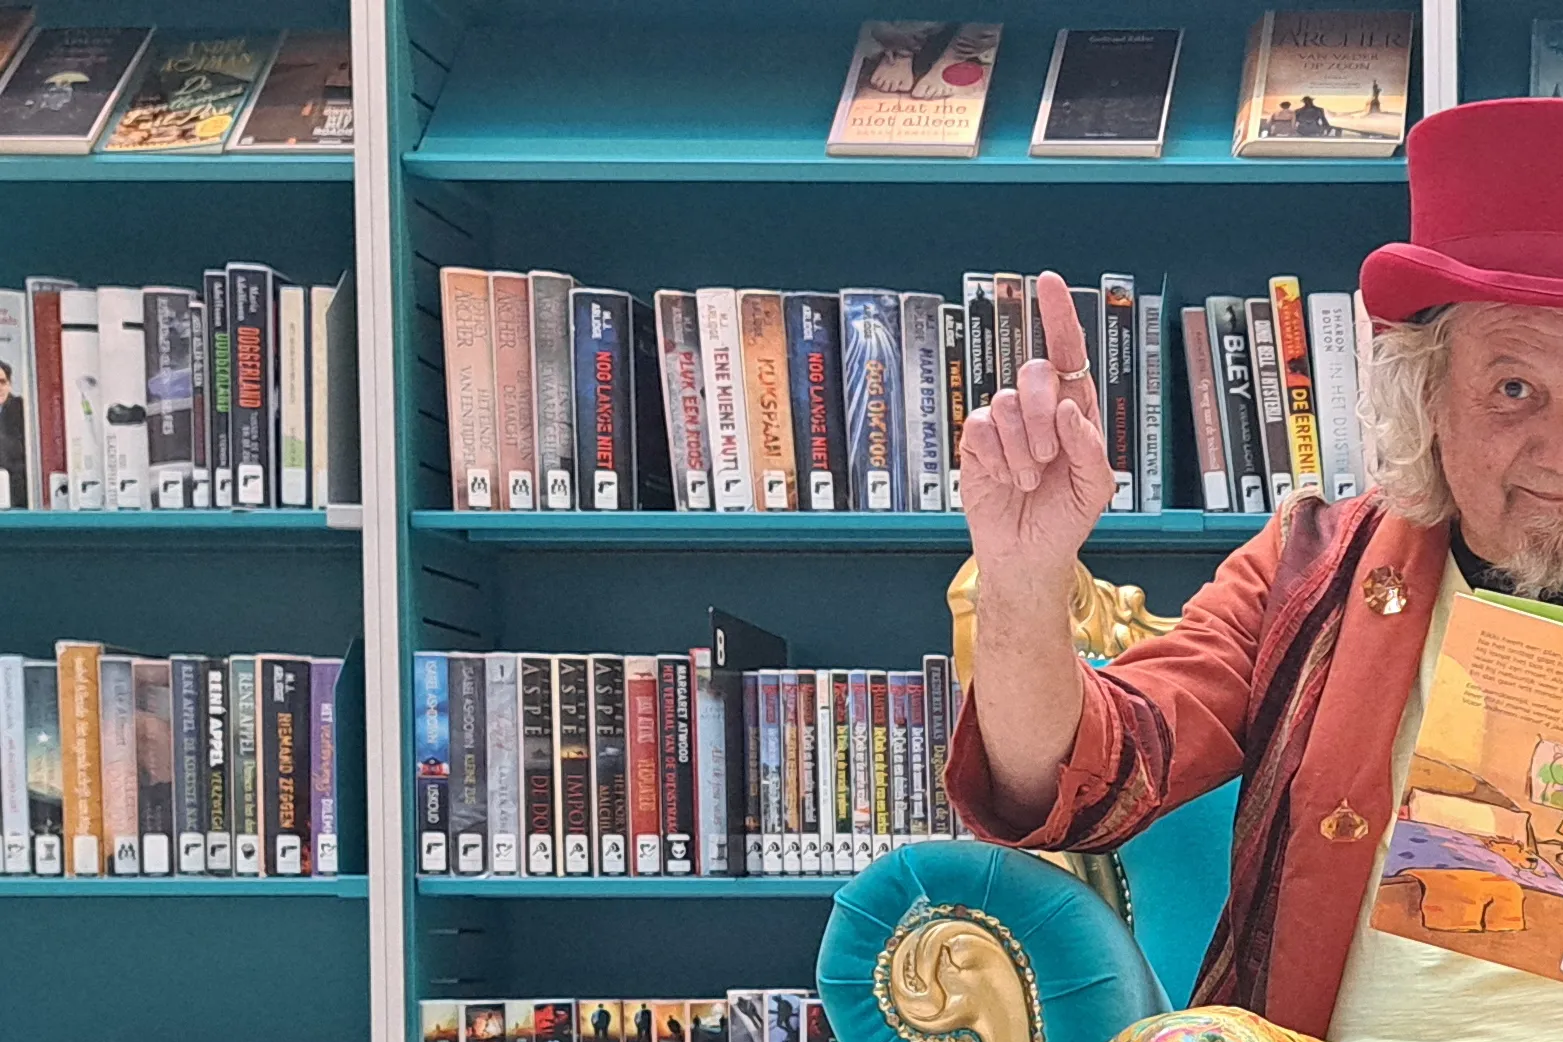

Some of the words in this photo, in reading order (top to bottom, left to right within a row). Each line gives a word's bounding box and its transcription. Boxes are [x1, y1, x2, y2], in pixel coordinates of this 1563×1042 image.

[876, 102, 926, 113] Laat
[1333, 309, 1344, 353] SHARON
[237, 327, 261, 408] DOGGERLAND
[596, 351, 612, 380] NOG
[679, 352, 695, 389] PLUK
[808, 353, 824, 382] NOG
[1223, 335, 1251, 399] BLEY
[682, 396, 698, 425] EEN
[598, 436, 614, 468] NIET
[812, 437, 829, 469] NIET
[208, 671, 227, 714] RENÉ
[523, 663, 540, 735] ASPE
[560, 663, 576, 735] ASPE
[595, 663, 613, 735] ASPE
[677, 665, 688, 719] MARGARET
[208, 717, 225, 768] APPEL
[677, 721, 689, 763] ATWOOD
